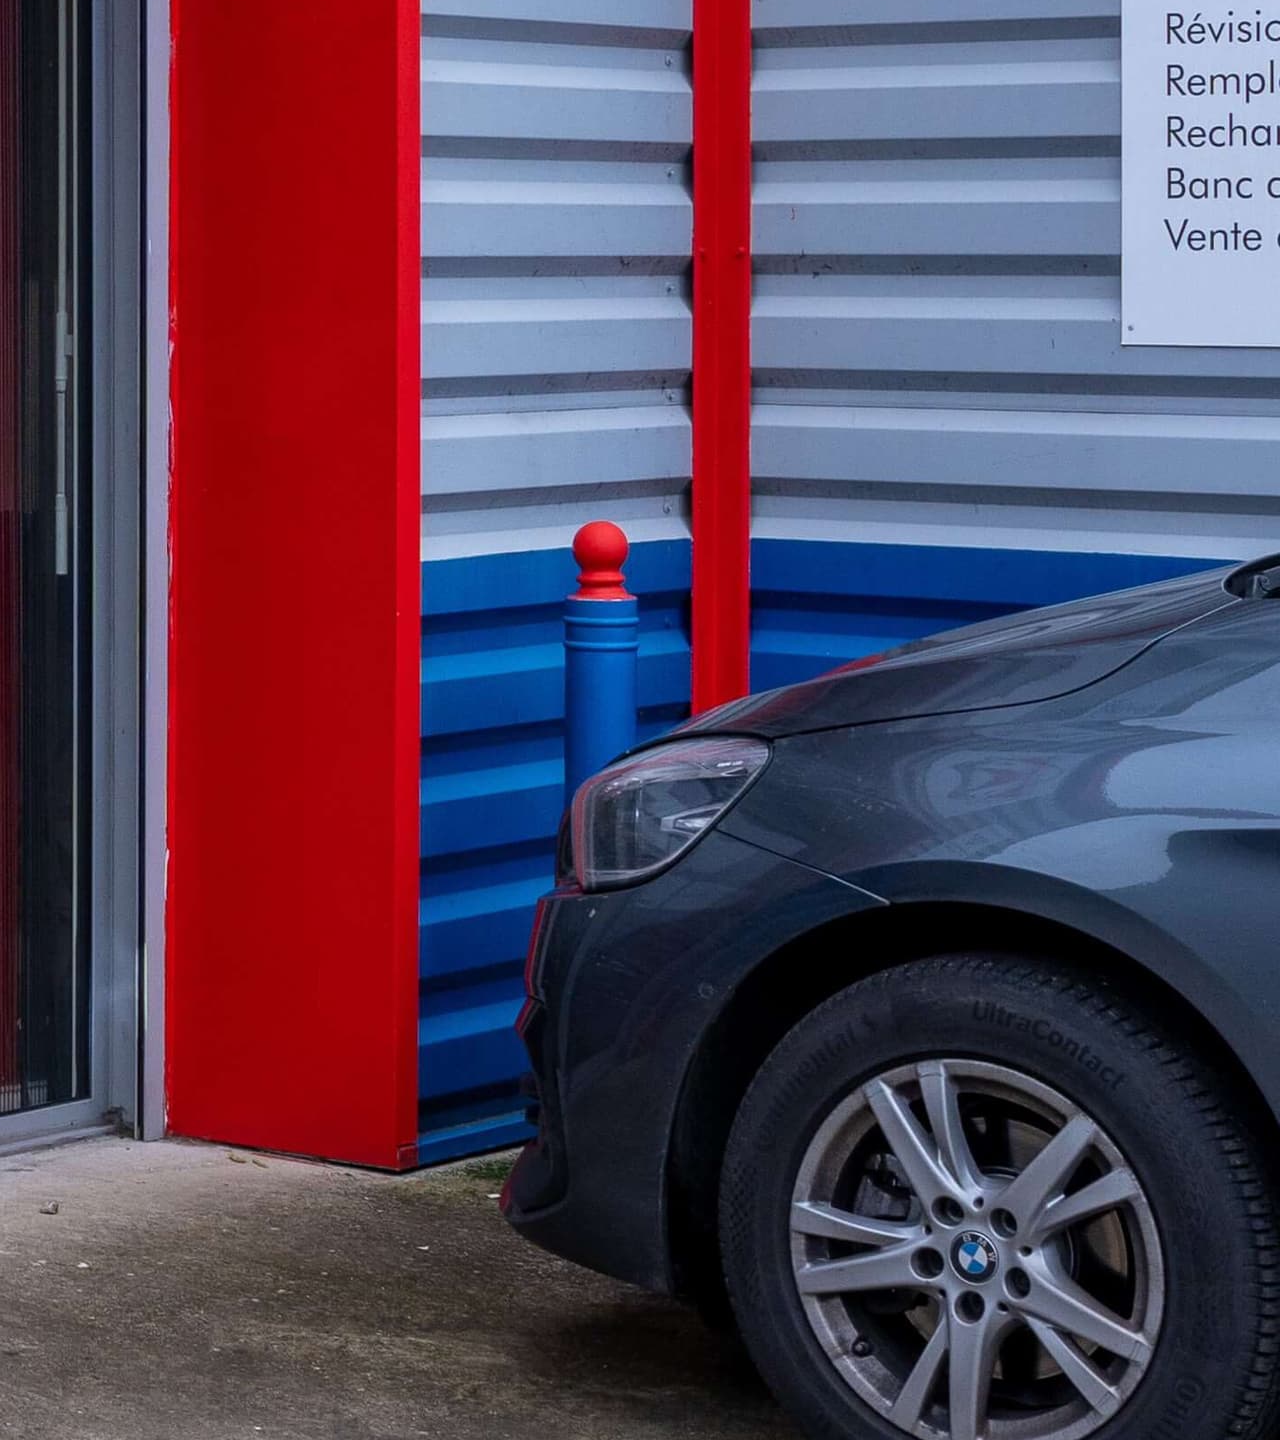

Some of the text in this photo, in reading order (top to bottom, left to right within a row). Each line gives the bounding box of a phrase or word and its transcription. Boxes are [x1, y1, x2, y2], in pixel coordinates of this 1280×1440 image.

[1167, 59, 1280, 103] Rempl
[1168, 168, 1252, 199] Banc
[1164, 219, 1262, 251] Vente
[962, 1232, 998, 1262] BMW
